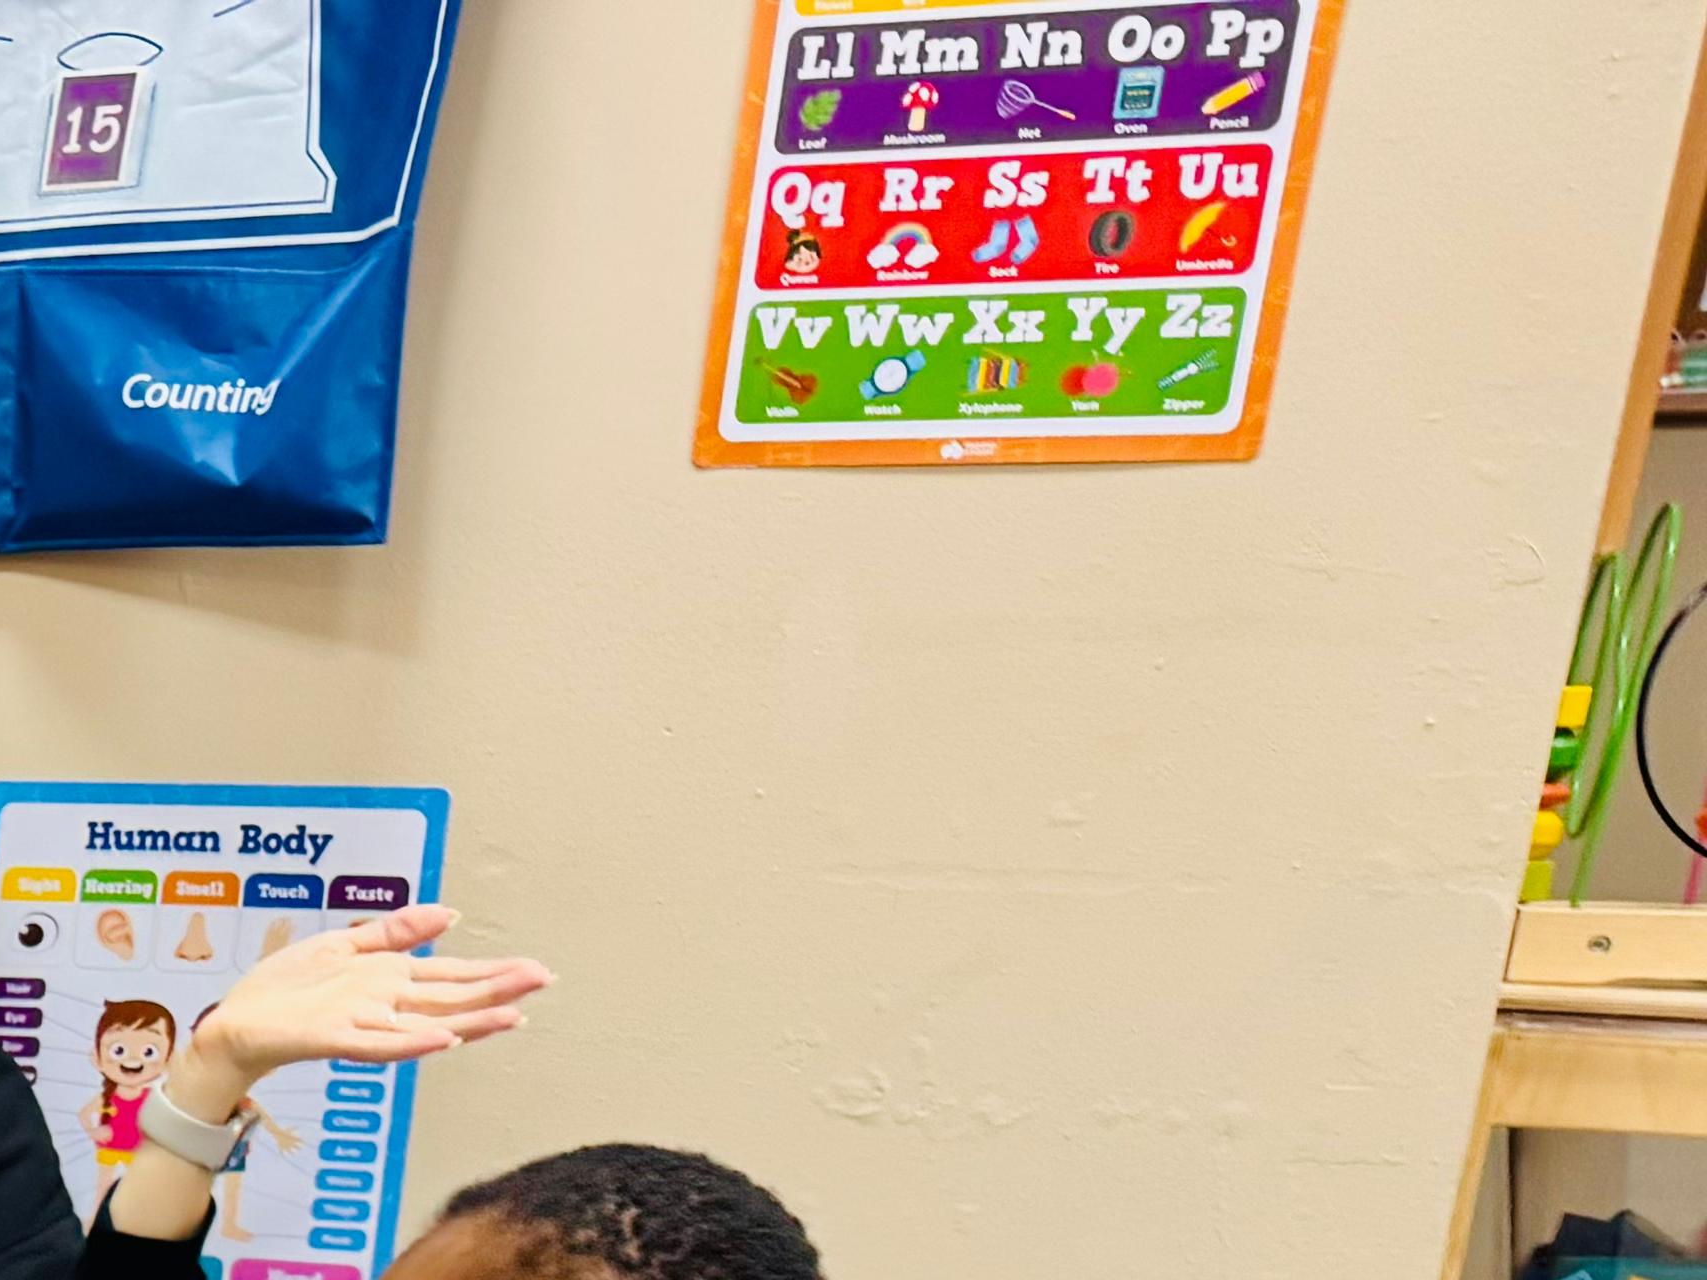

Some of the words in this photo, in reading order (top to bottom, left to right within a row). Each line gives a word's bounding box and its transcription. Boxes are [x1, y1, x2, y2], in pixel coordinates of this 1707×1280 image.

[797, 32, 855, 80] Ll
[876, 29, 979, 76] Mm
[999, 22, 1083, 68] Nn
[1107, 15, 1185, 62] Oo
[1206, 9, 1285, 68] Pp
[61, 103, 123, 154] 15
[1114, 123, 1148, 135] Oven
[1209, 116, 1249, 130] Pencil
[1018, 127, 1041, 139] Net
[798, 137, 827, 150] Leaf
[771, 171, 846, 229] Qq
[879, 168, 954, 212] Rr
[983, 160, 1050, 209] Ss
[1083, 156, 1154, 203] Tt
[1179, 152, 1259, 200] Uu
[988, 266, 1018, 279] Sock
[1095, 262, 1120, 275] Tire
[1175, 258, 1234, 272] Umbrella
[756, 307, 833, 350] Vv
[844, 304, 954, 347] Ww
[962, 300, 1045, 344] Xx
[1067, 297, 1145, 355] Yy
[1160, 294, 1234, 339] Zz
[122, 373, 282, 416] Counting
[864, 403, 901, 416] Watch
[1163, 398, 1205, 411] Zipper
[86, 822, 221, 853] Human
[239, 825, 333, 864] Body
[86, 878, 153, 899] Hearing
[176, 881, 224, 897] Smell
[258, 883, 309, 899] Touch
[345, 885, 394, 902] Taste
